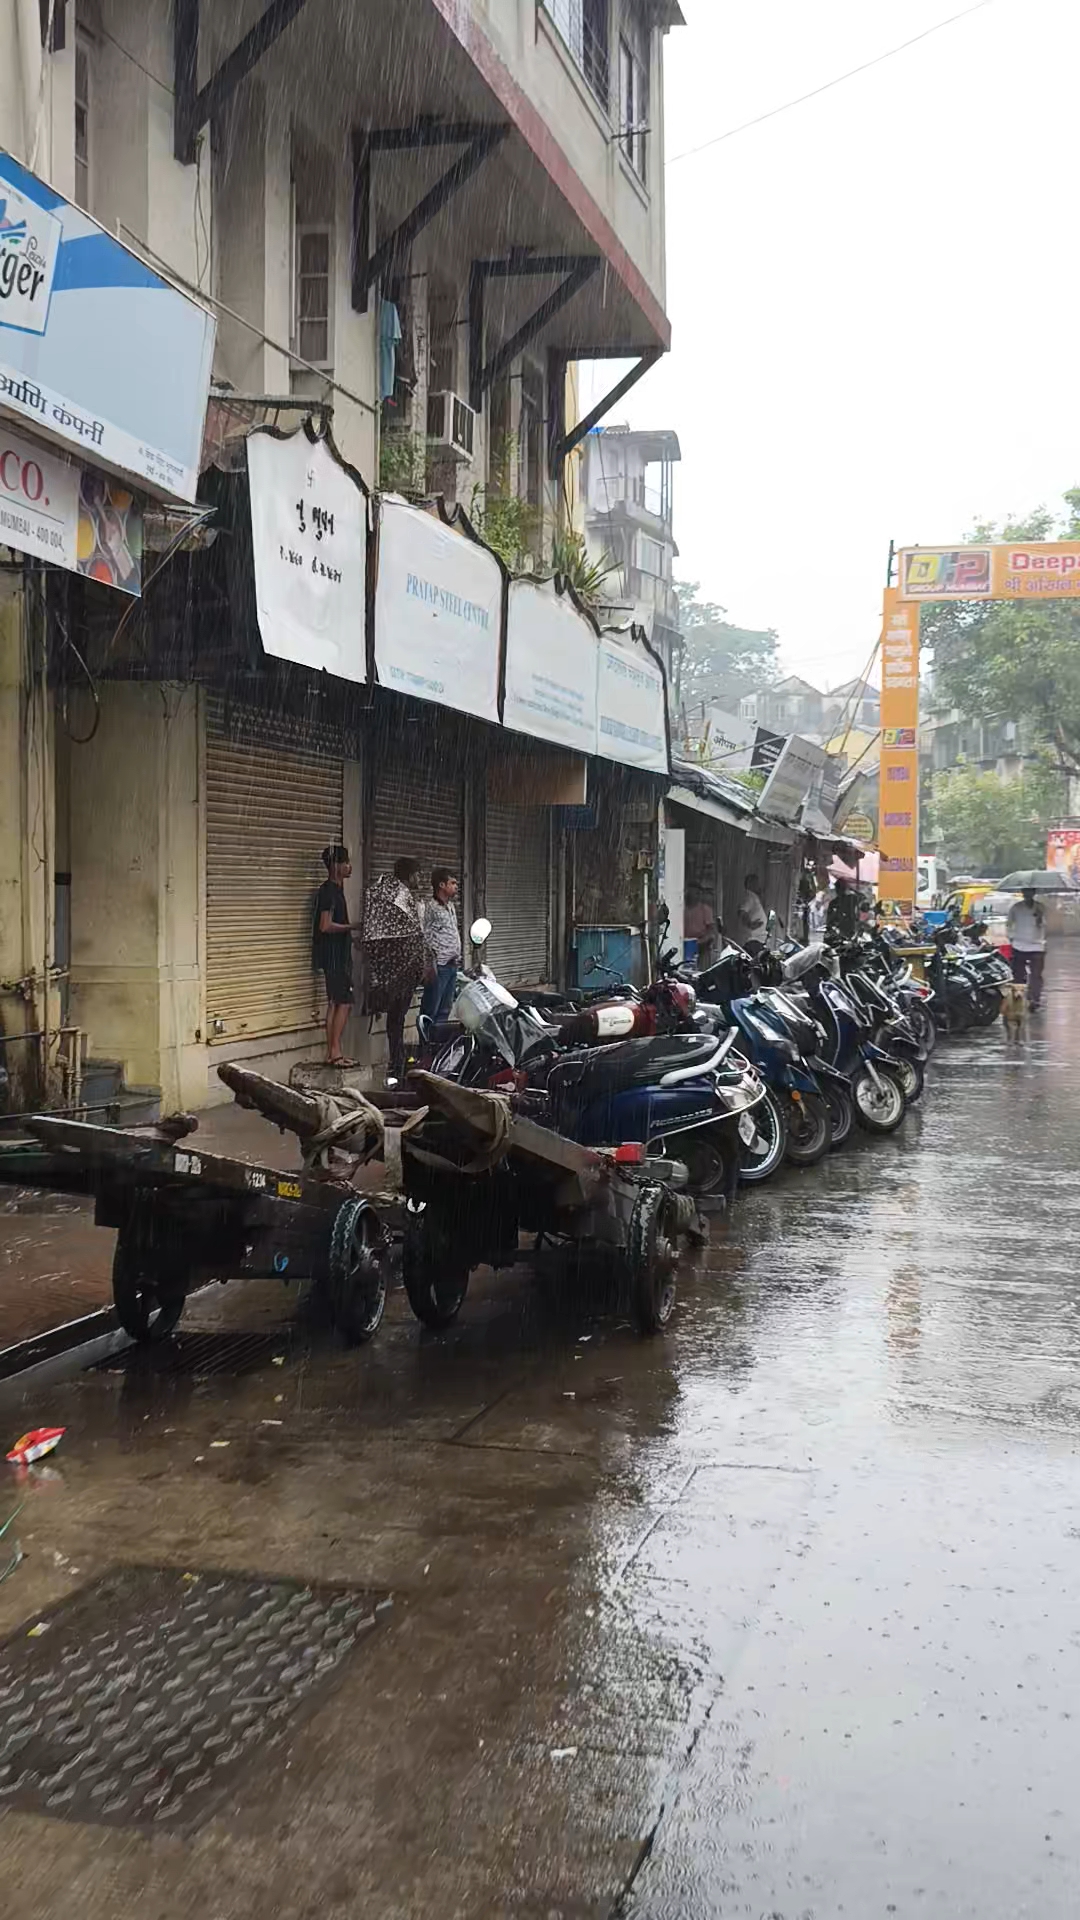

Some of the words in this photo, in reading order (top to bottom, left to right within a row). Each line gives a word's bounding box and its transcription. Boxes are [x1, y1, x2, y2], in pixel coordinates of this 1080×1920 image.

[53, 403, 104, 445] कंपनी
[0, 450, 50, 506] CO.
[406, 573, 439, 604] PRATAP
